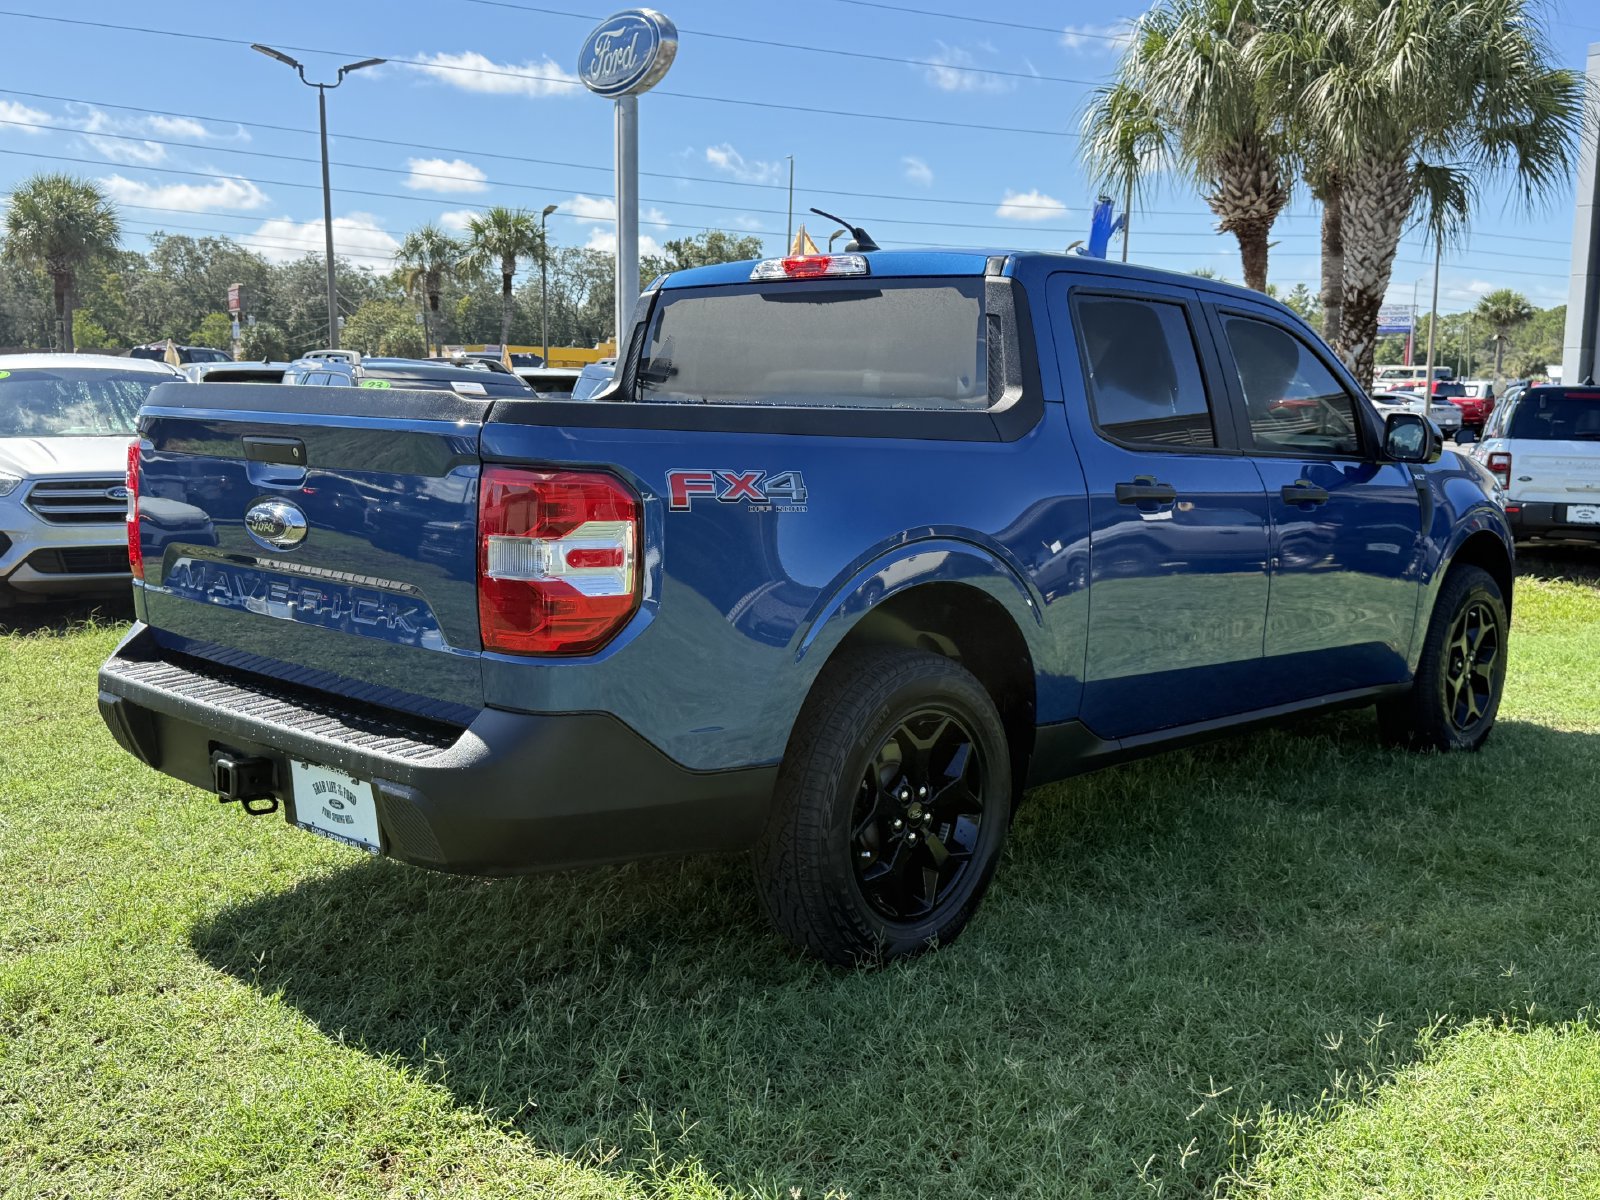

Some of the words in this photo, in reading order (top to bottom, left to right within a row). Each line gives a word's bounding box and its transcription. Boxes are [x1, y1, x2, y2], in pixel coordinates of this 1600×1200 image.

[590, 25, 639, 81] Ford
[665, 468, 808, 512] FX4
[251, 511, 276, 533] Ford
[180, 563, 418, 634] MAVERICK
